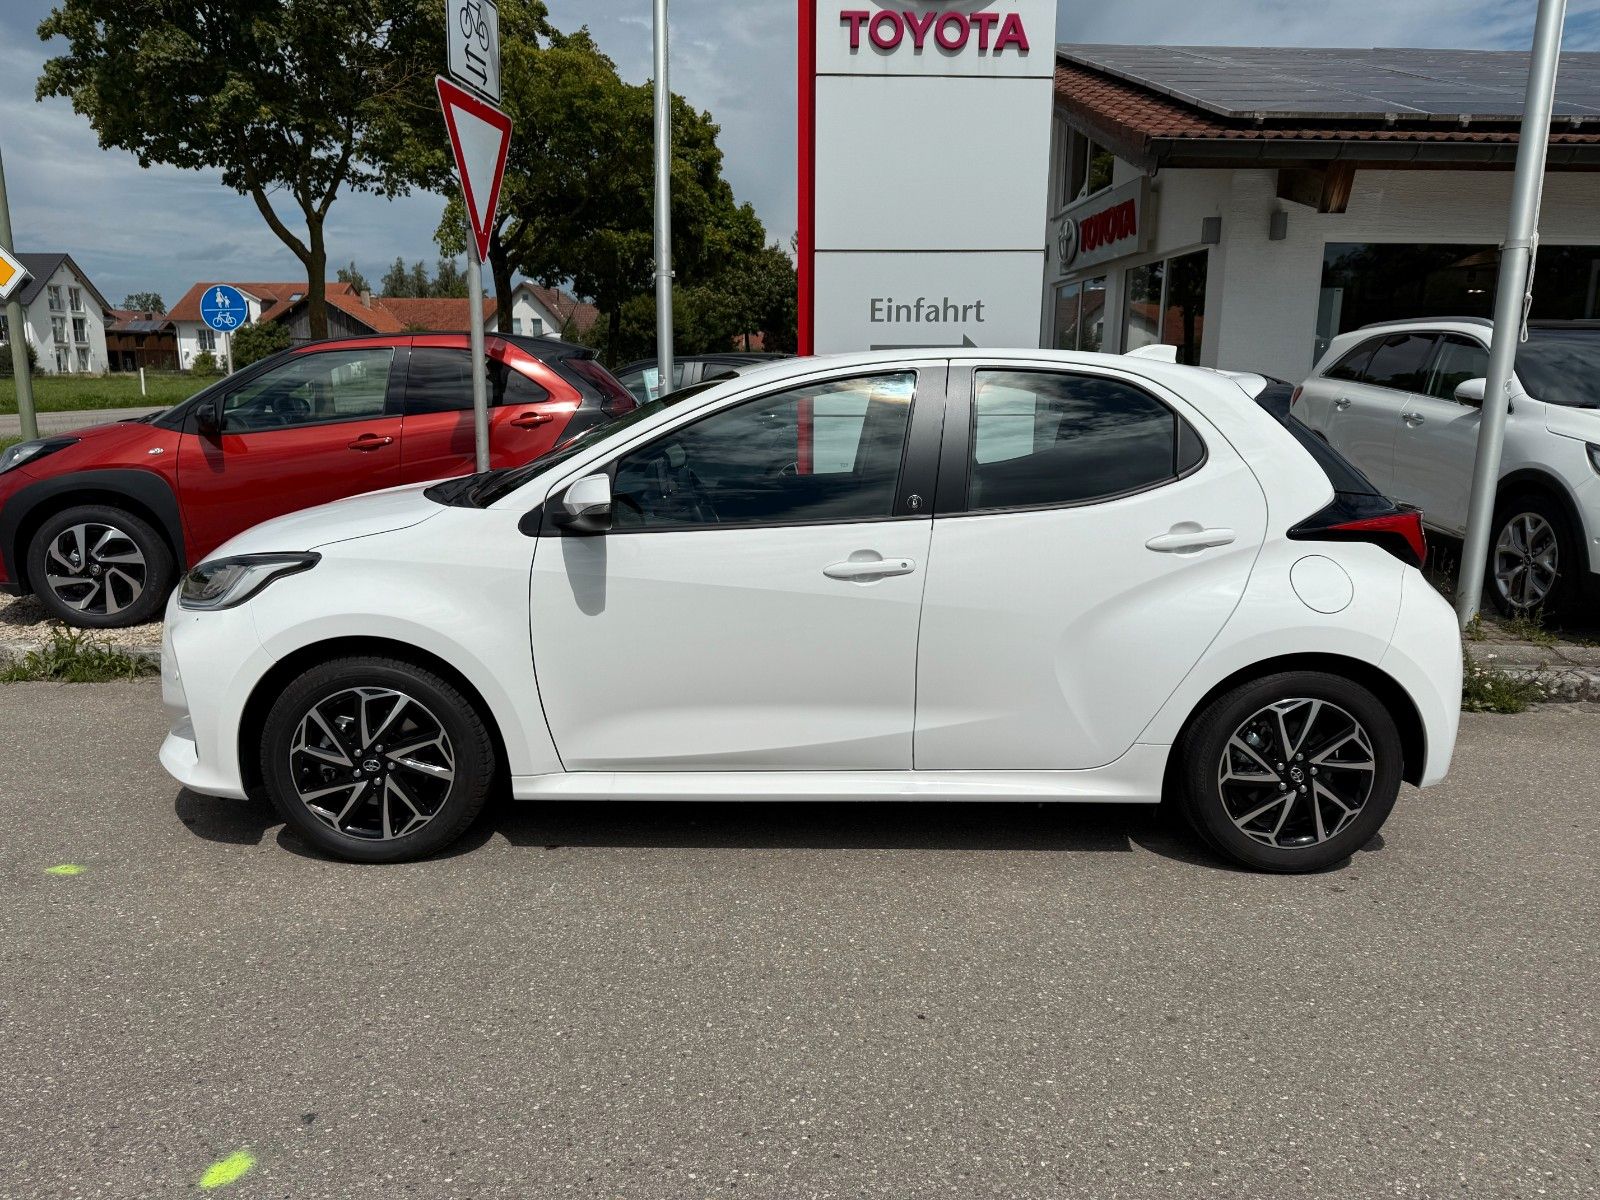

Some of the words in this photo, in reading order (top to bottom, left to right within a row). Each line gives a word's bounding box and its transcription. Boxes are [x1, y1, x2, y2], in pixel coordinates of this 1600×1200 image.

[840, 10, 1030, 51] TOYOTA
[1080, 198, 1137, 253] TOYOTA
[870, 297, 985, 322] Einfahrt
